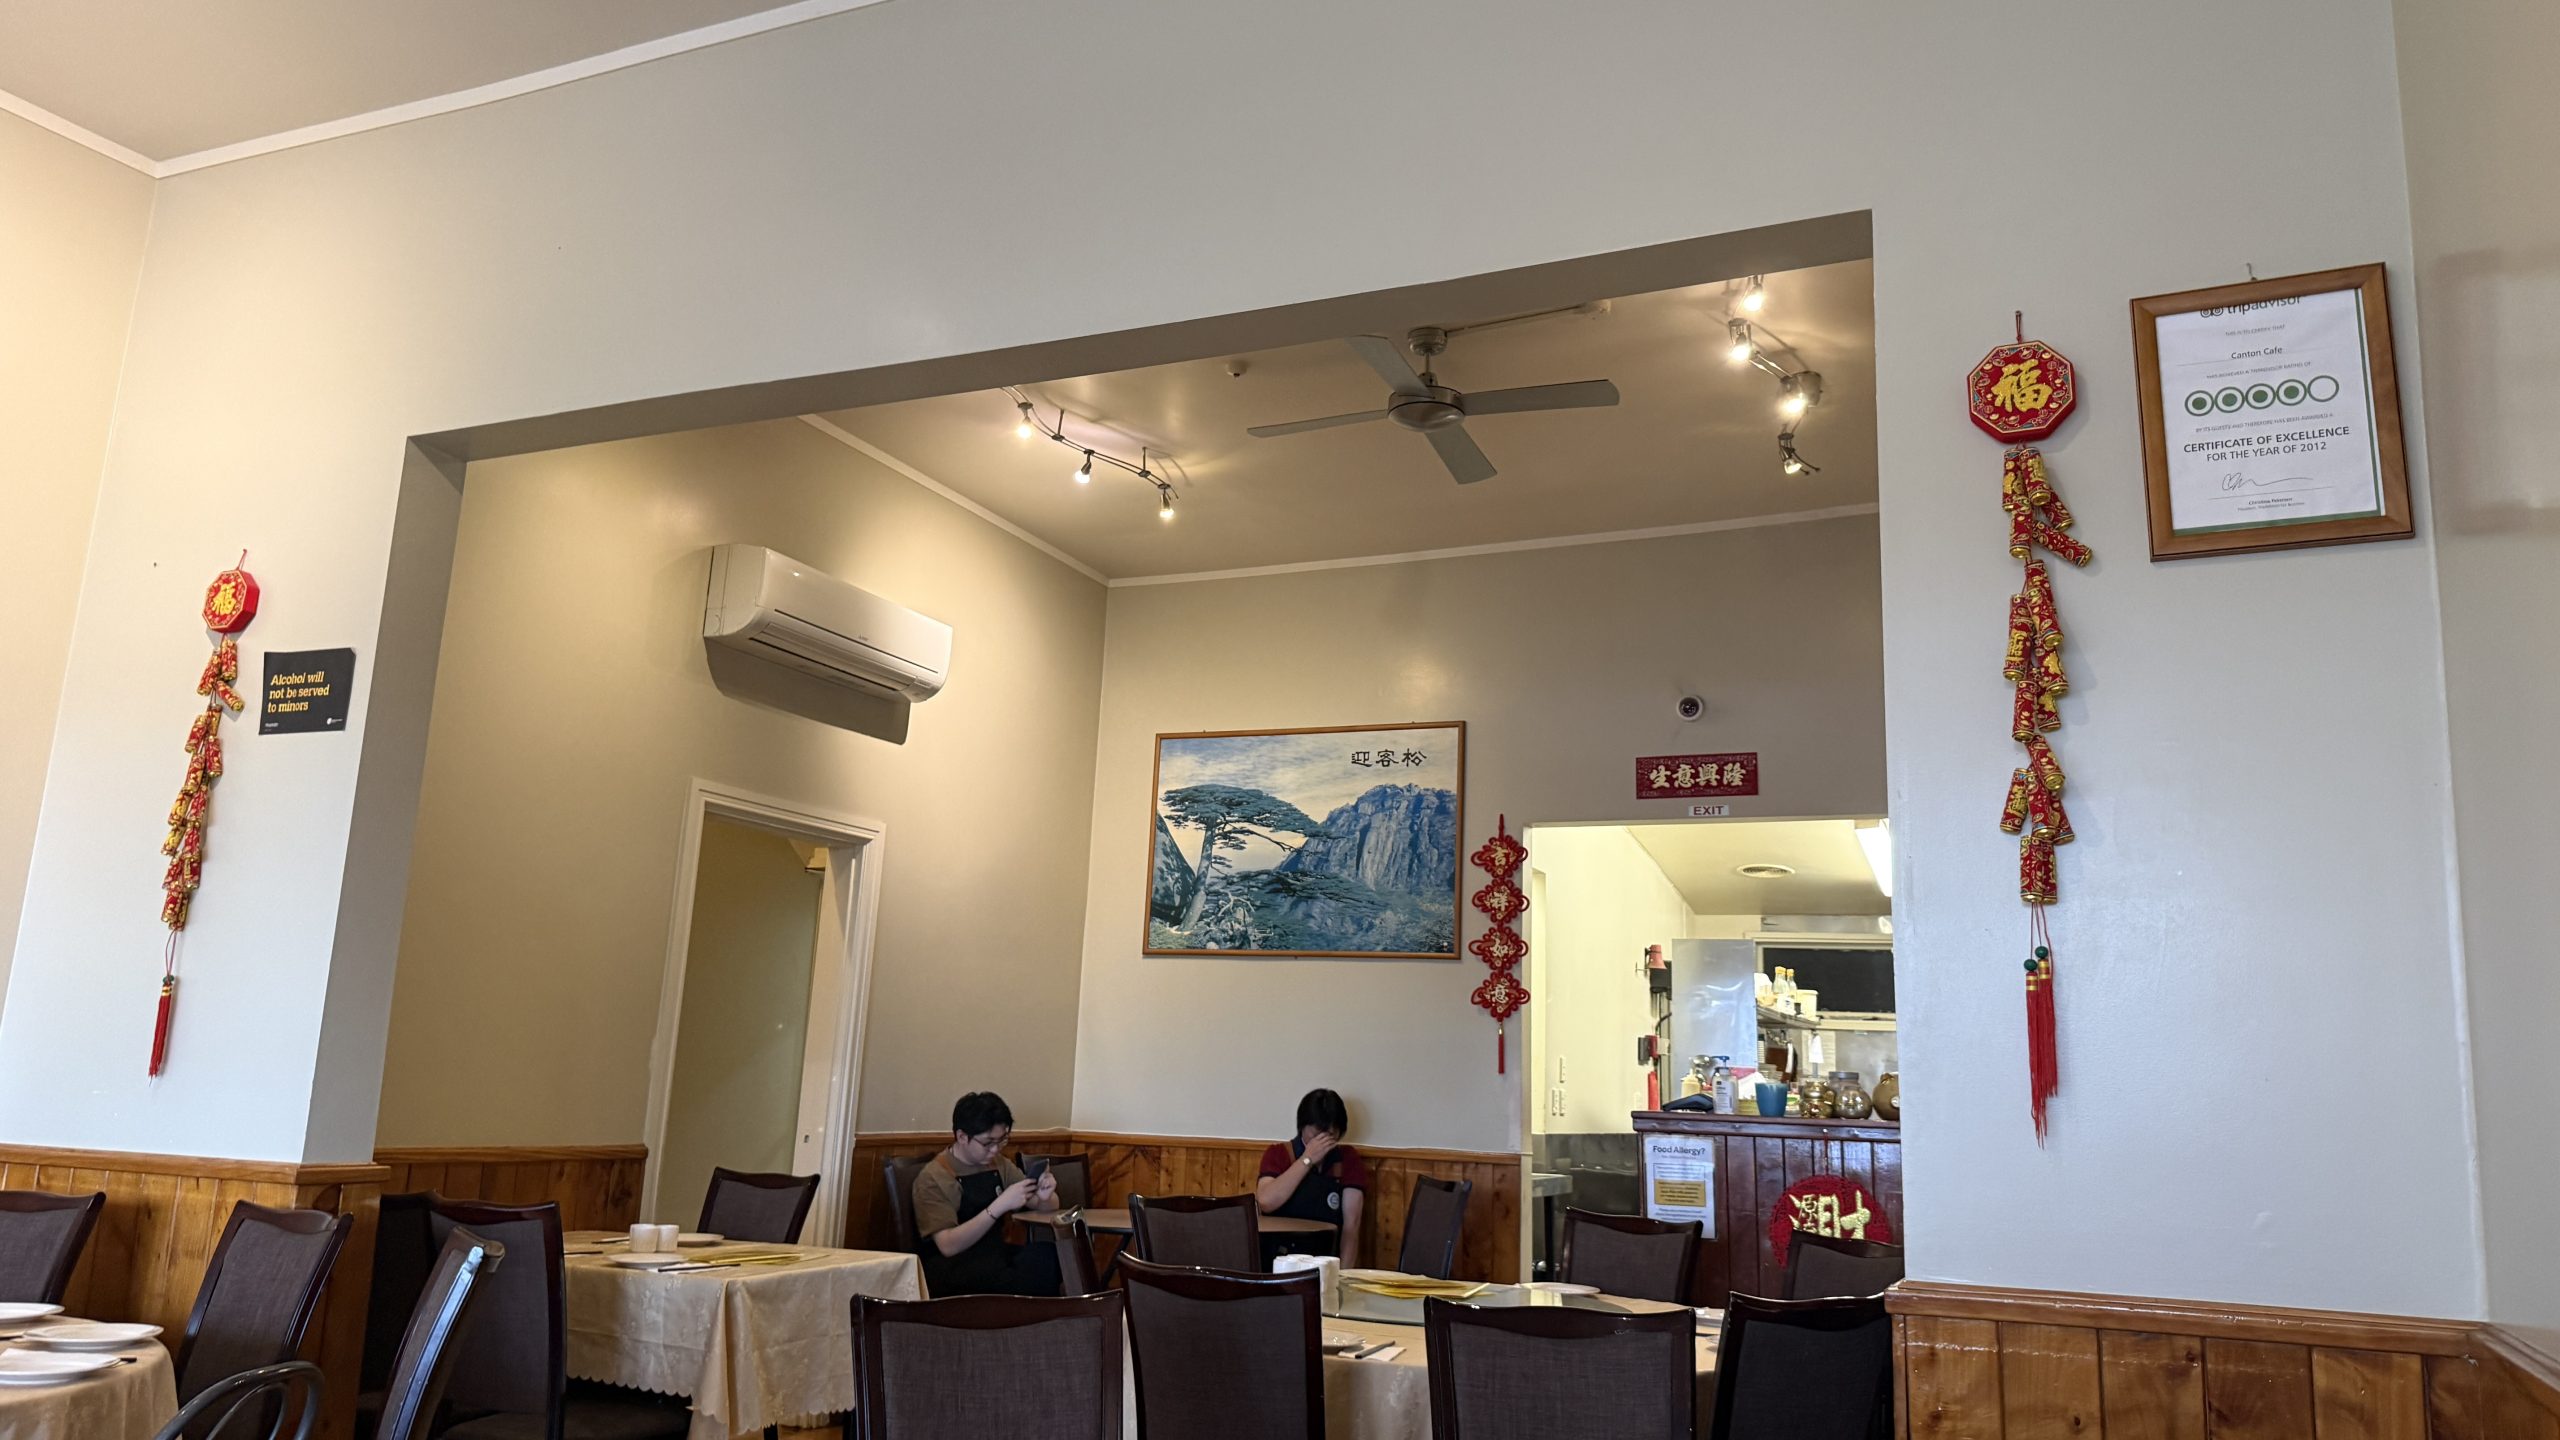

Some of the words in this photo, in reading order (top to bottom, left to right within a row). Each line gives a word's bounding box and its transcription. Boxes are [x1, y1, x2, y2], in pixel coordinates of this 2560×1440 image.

[2231, 350, 2261, 360] Canton
[2263, 346, 2283, 356] Cafe
[1990, 359, 2053, 413] 福
[2184, 437, 2253, 453] CERTIFICATE
[2256, 435, 2272, 445] OF
[2276, 426, 2350, 443] EXCELLENCE
[2206, 452, 2227, 462] FOR
[2230, 450, 2250, 460] THE
[2252, 446, 2280, 457] YEAR
[2283, 444, 2297, 454] OF
[2300, 441, 2327, 452] 2012
[270, 672, 306, 686] Alcohol
[308, 671, 325, 684] will
[268, 687, 285, 700] not
[286, 687, 297, 699] be
[298, 684, 330, 697] served
[267, 702, 277, 713] to
[278, 700, 309, 712] minors
[1351, 747, 1427, 768] 迎客松
[1650, 762, 1747, 789] 生意興隆
[1693, 805, 1724, 816] EXIT
[1652, 1145, 1672, 1153] Food
[1673, 1145, 1706, 1156] Allergy?
